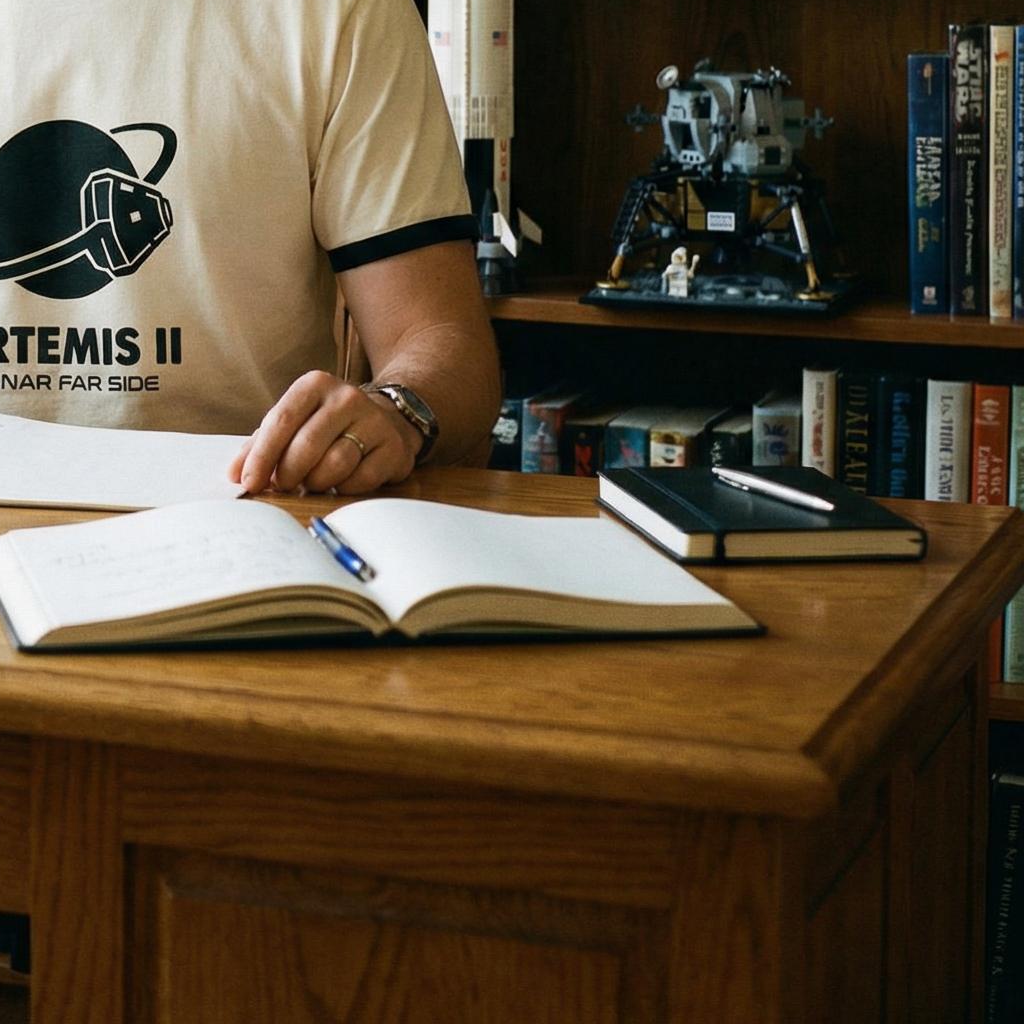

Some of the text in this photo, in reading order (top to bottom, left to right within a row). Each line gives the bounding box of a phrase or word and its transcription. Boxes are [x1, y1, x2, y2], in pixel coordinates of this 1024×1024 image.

[156, 327, 182, 365] II
[59, 375, 102, 391] FAR
[108, 375, 160, 391] SIDE
